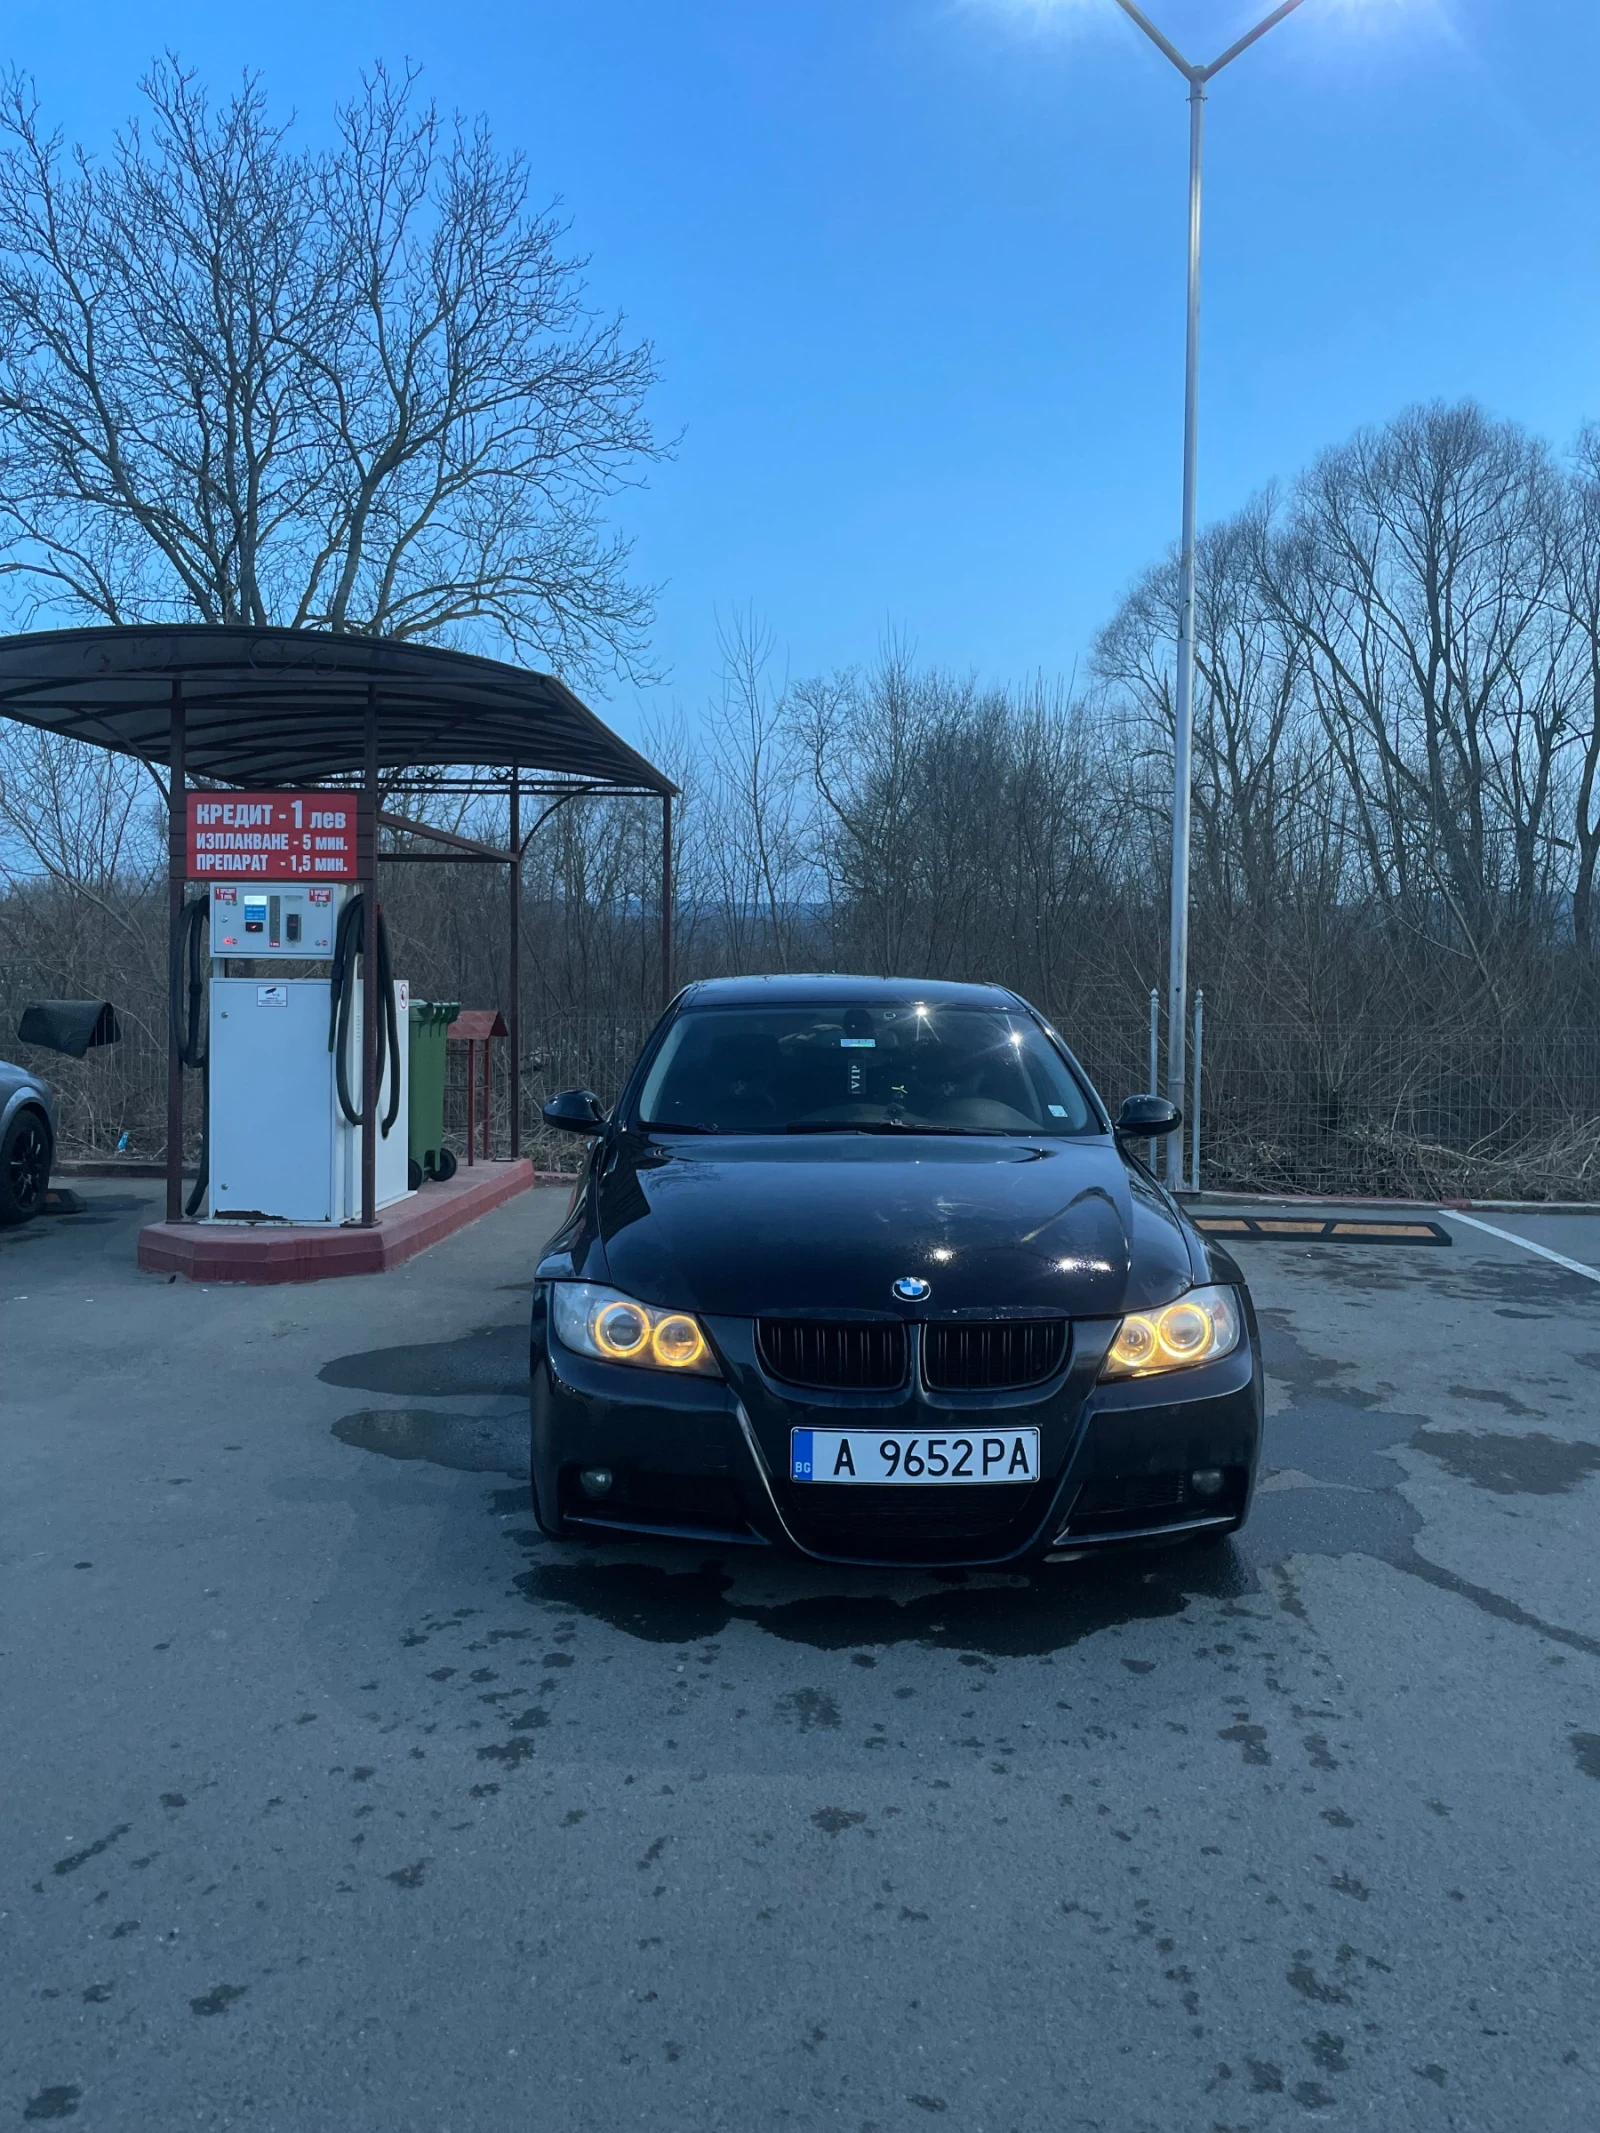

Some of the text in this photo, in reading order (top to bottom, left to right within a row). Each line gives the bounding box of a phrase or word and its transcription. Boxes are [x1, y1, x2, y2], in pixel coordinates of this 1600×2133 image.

[196, 804, 273, 828] КРЕДИТ
[290, 800, 303, 829] 1
[309, 811, 347, 829] лев
[196, 833, 289, 850] ИЗПЛАКВАНЕ
[302, 833, 312, 850] 5
[315, 836, 348, 851] мин.
[196, 853, 268, 871] ПРЕПАРАТ
[290, 854, 311, 874] 1,5
[314, 857, 348, 872] мин.
[851, 1065, 861, 1090] VIP
[795, 1461, 811, 1474] BG
[833, 1438, 856, 1476] A
